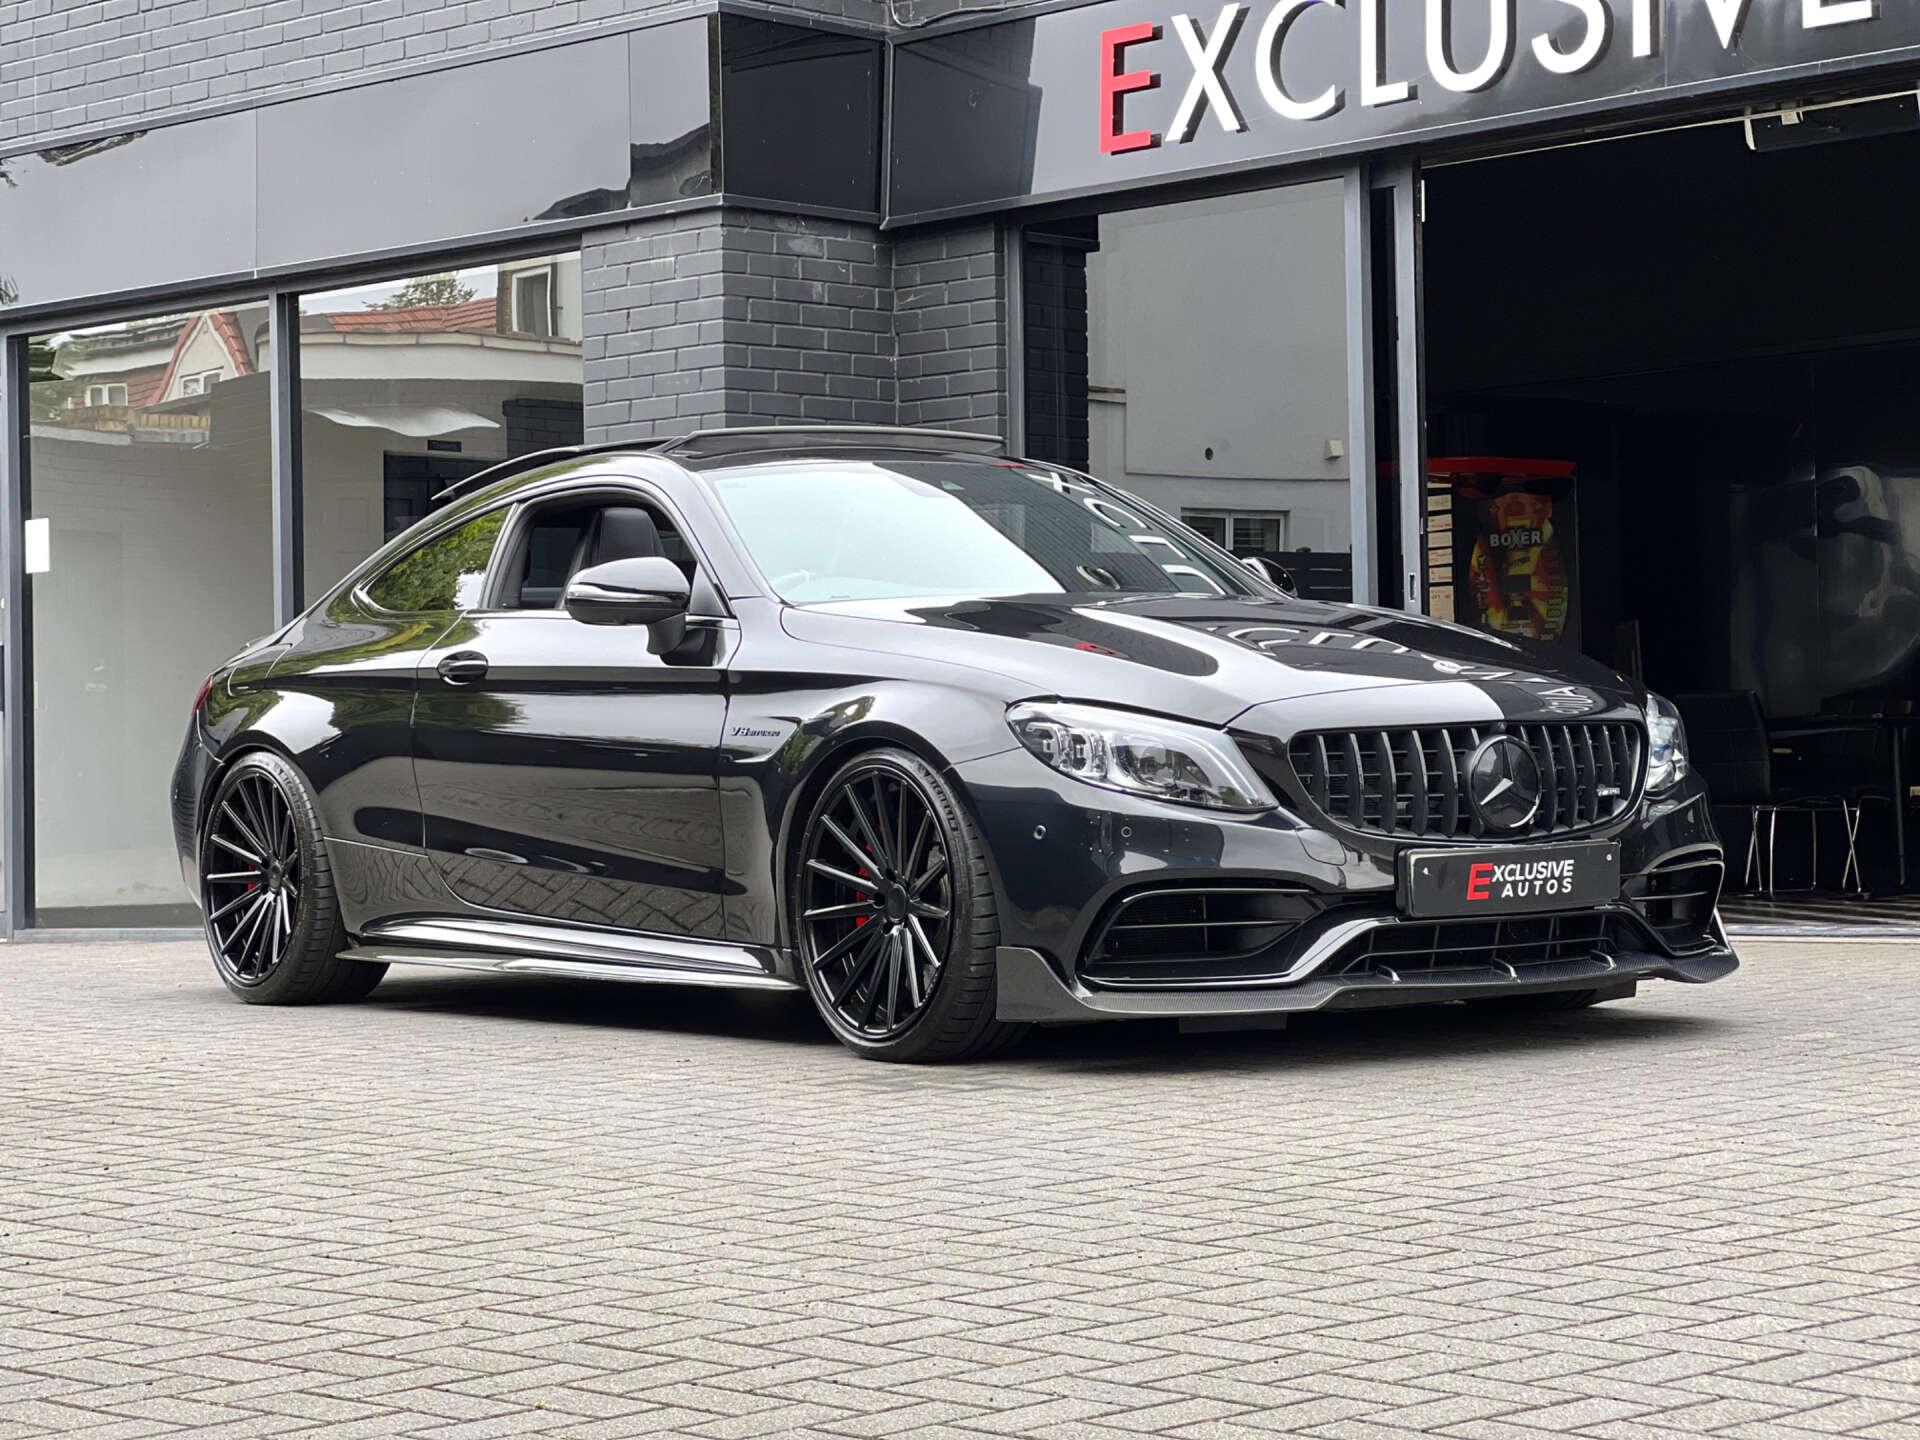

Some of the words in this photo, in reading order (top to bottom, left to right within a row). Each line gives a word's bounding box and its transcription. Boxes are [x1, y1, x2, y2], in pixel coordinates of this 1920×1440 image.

[1490, 529, 1542, 549] BOXER
[1467, 860, 1574, 900] EXCLUSIVE
[1501, 878, 1572, 898] AUTOS
